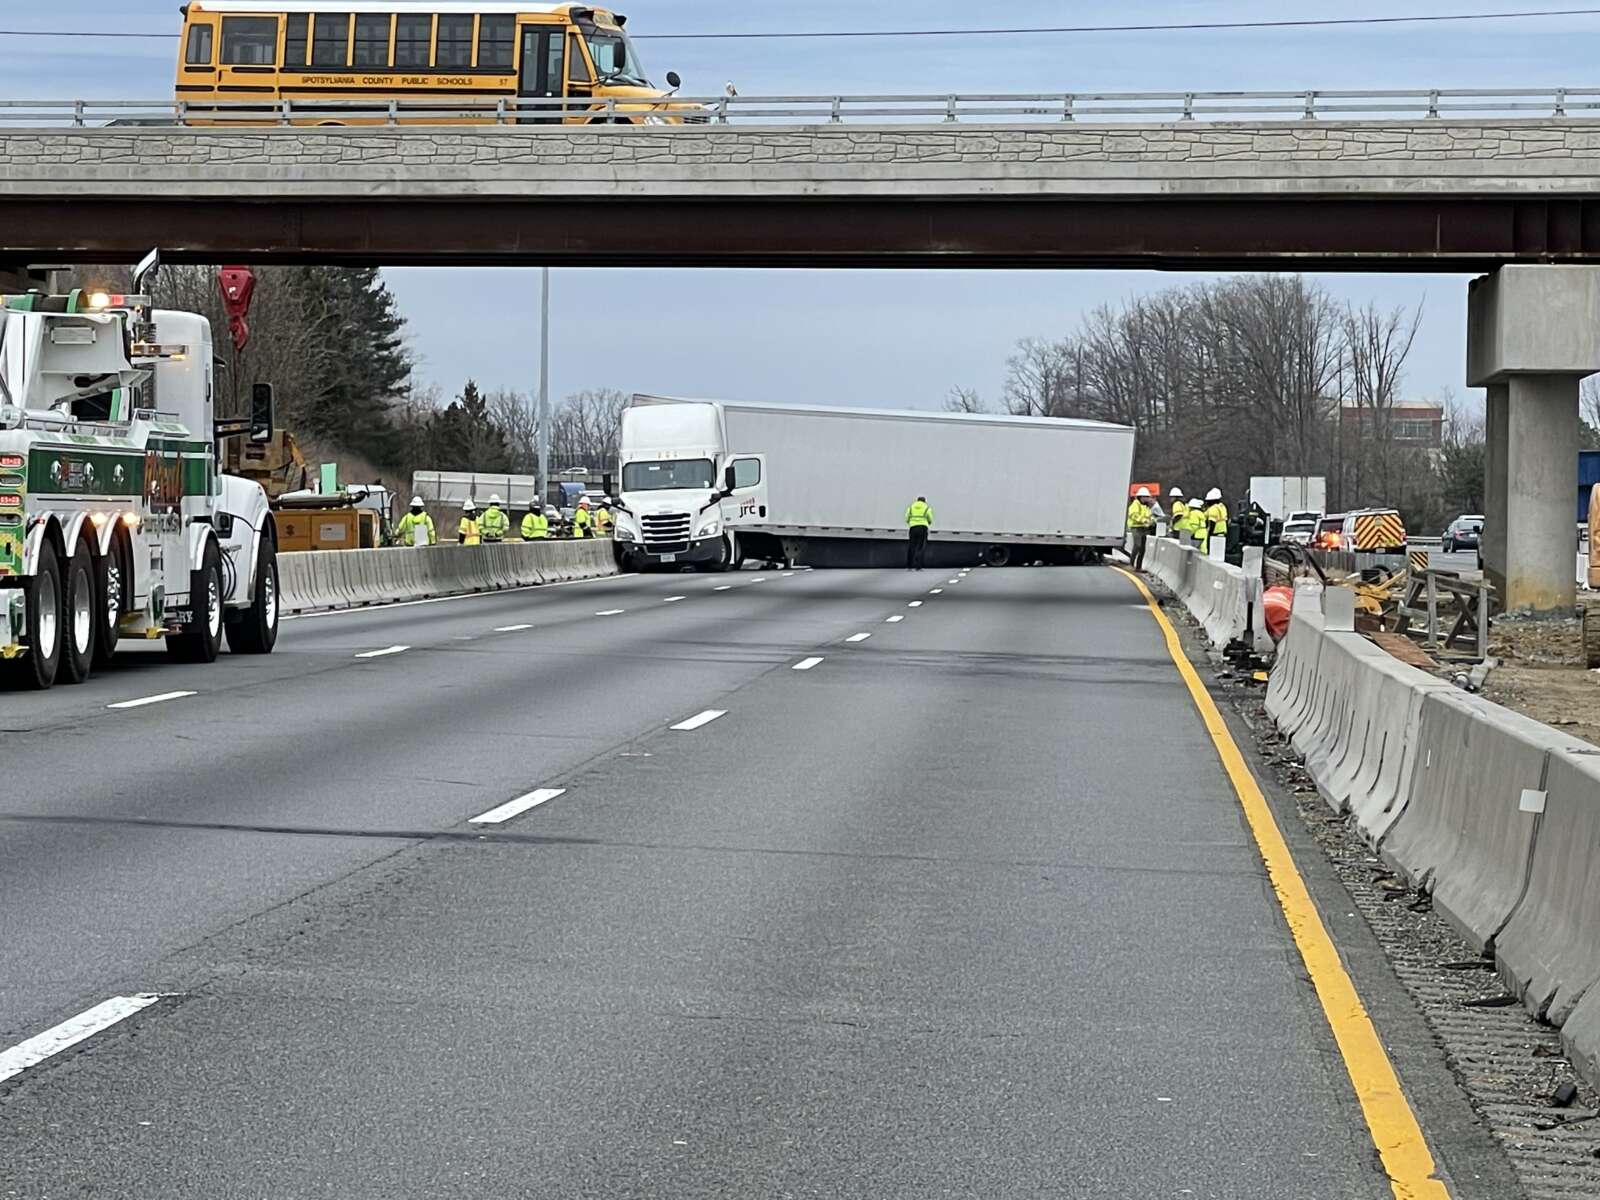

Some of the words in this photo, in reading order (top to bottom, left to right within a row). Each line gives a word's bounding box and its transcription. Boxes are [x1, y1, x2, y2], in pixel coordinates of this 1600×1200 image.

[302, 76, 355, 85] SPOTSYLVANIA
[362, 76, 394, 85] COUNTY
[401, 77, 429, 85] PUBLIC
[437, 77, 473, 86] SCHOOLS
